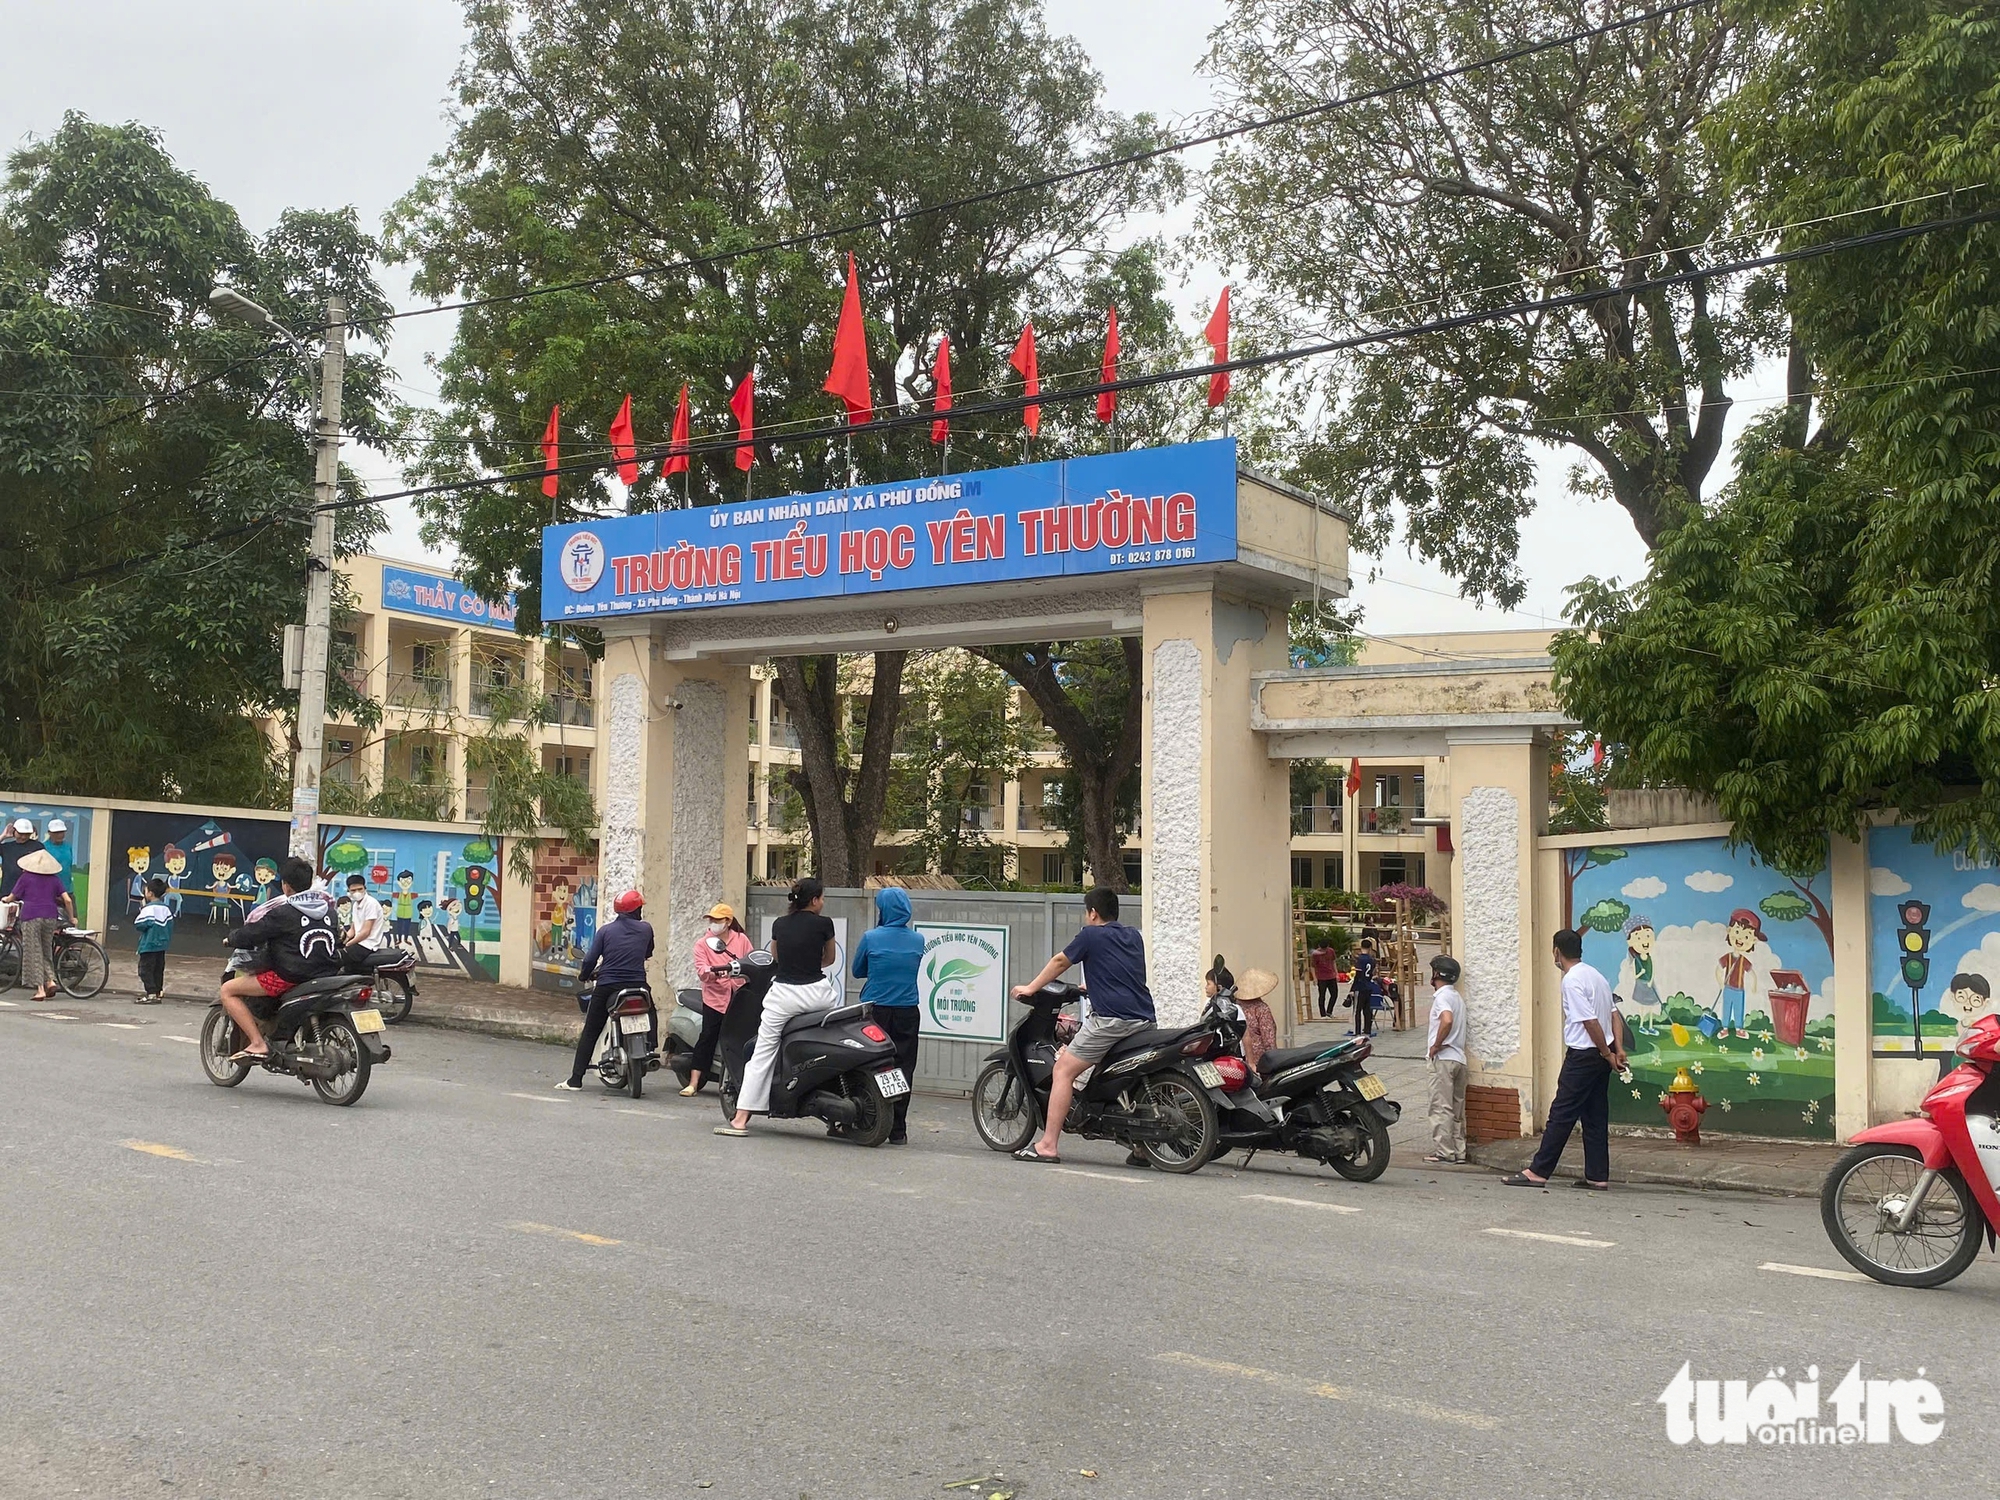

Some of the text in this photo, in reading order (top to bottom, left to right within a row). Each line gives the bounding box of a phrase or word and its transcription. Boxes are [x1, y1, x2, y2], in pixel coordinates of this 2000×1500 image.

[709, 480, 961, 528] ỦY BAN NHÂN DÂN XÃ PHÙ ĐỔNG
[611, 489, 1198, 596] TRƯỜNG TIỂU HỌC YÊN THƯỜNG
[1128, 551, 1151, 563] 0243
[1154, 548, 1172, 561] 878
[1175, 547, 1196, 559] 0161
[414, 580, 456, 611] THẦY
[1365, 963, 1371, 977] 2
[882, 1081, 908, 1096] 327.59
